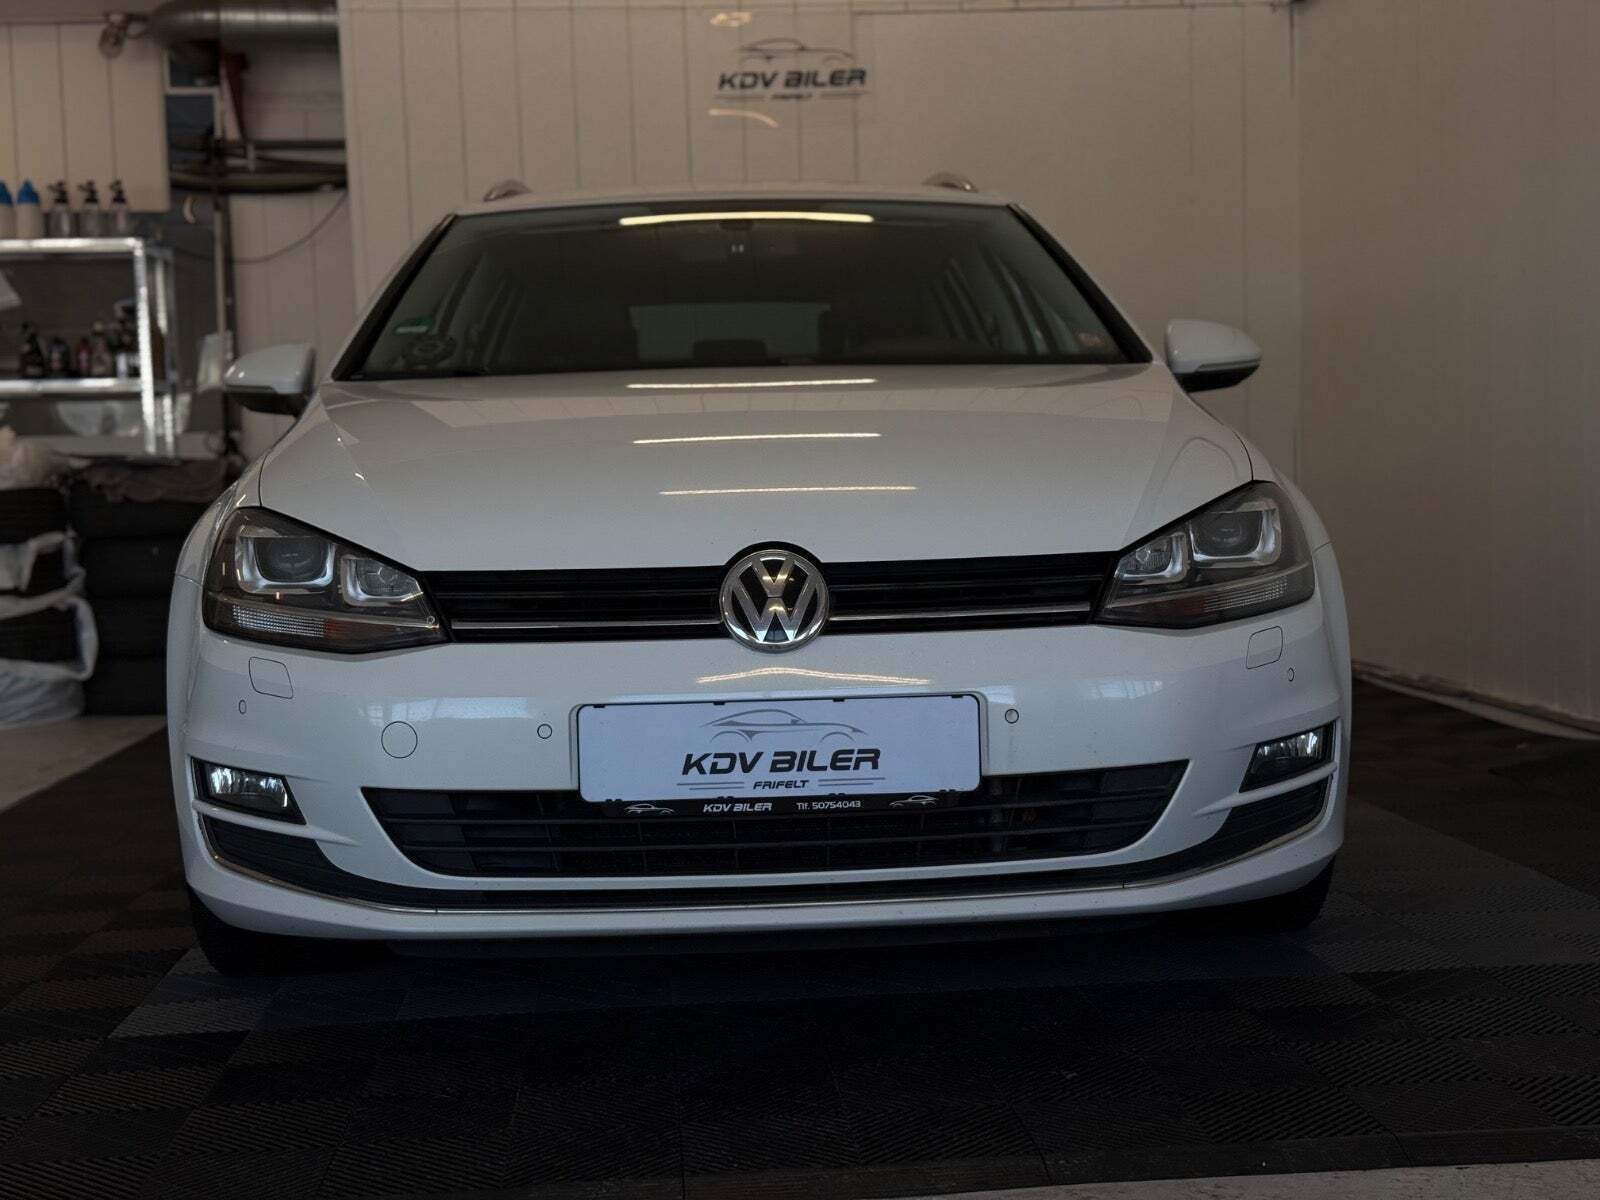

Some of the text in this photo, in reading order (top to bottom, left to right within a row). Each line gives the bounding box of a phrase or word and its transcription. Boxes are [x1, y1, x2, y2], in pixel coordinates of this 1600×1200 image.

[718, 69, 866, 89] KDV BILER
[682, 748, 881, 775] KDV BILER
[753, 779, 809, 790] FRIFELT
[703, 803, 732, 812] KDV
[733, 802, 773, 812] BILER
[811, 800, 861, 810] 50754043
